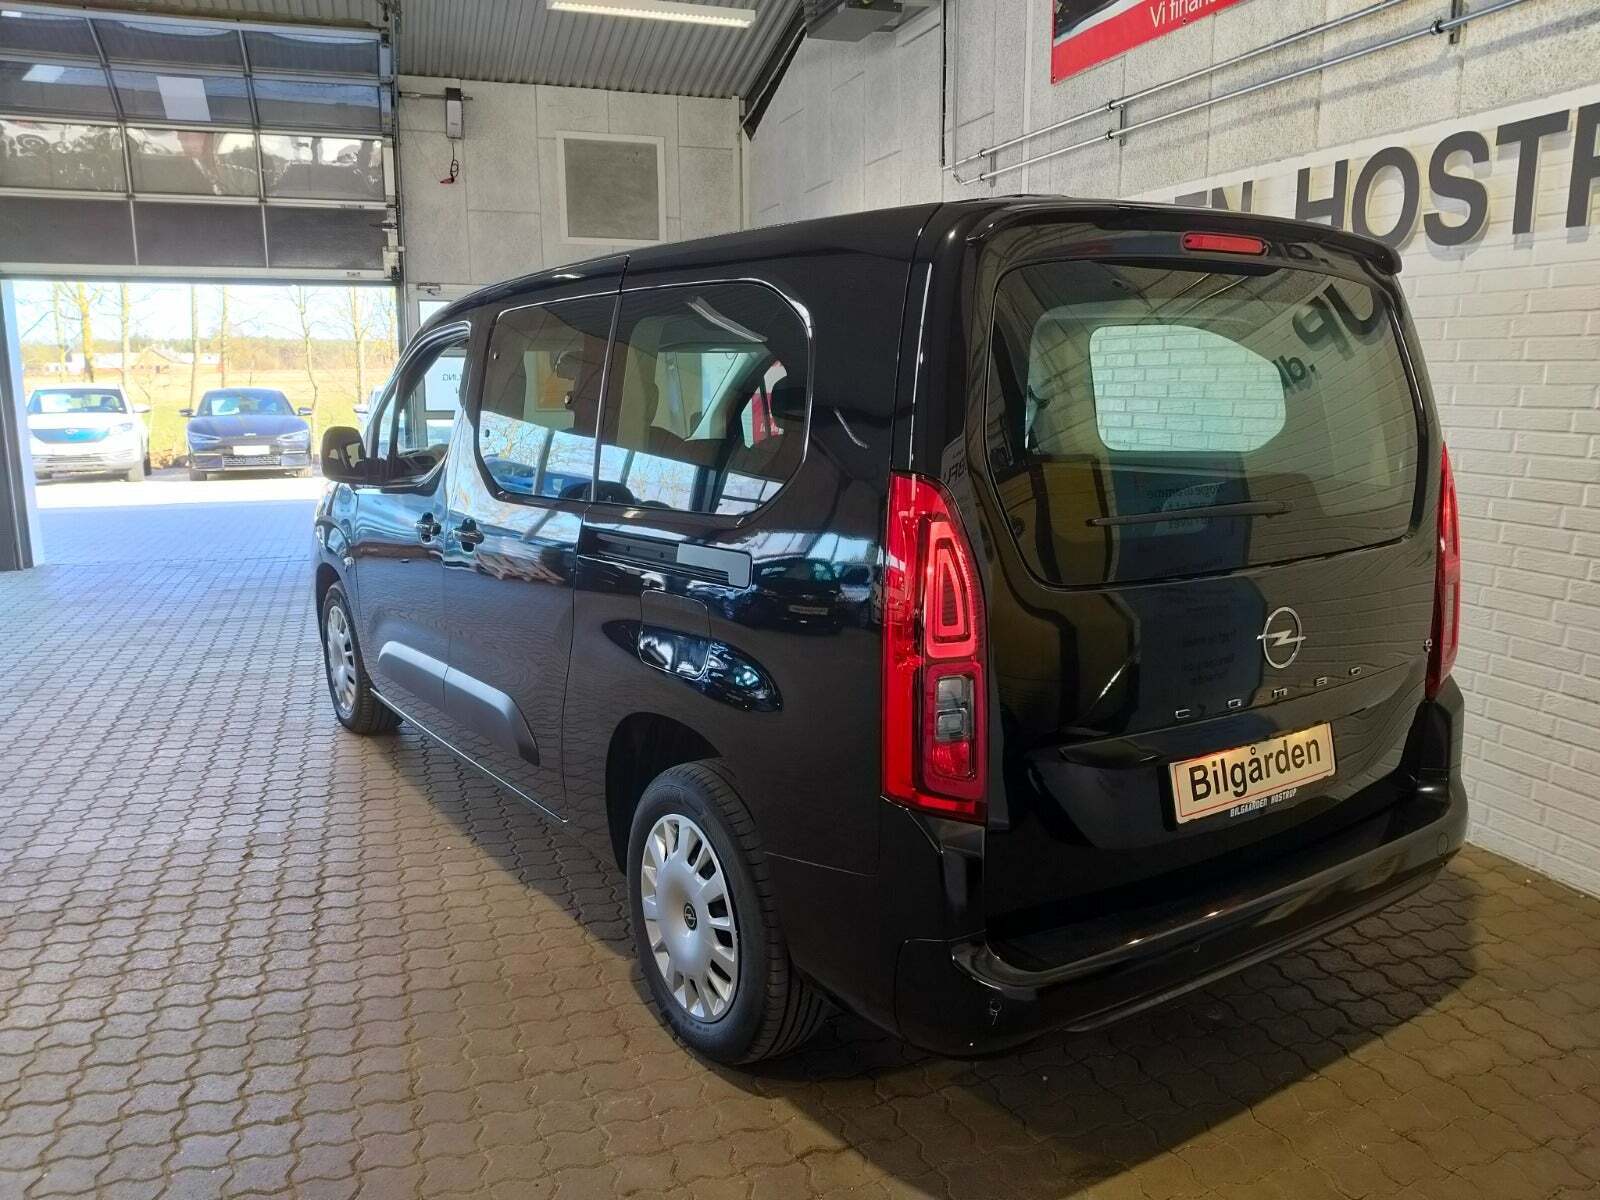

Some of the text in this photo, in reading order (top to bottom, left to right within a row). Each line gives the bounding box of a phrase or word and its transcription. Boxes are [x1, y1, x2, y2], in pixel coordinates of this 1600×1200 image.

[1150, 0, 1217, 28] Vi fina
[1189, 737, 1321, 803] Bilgården
